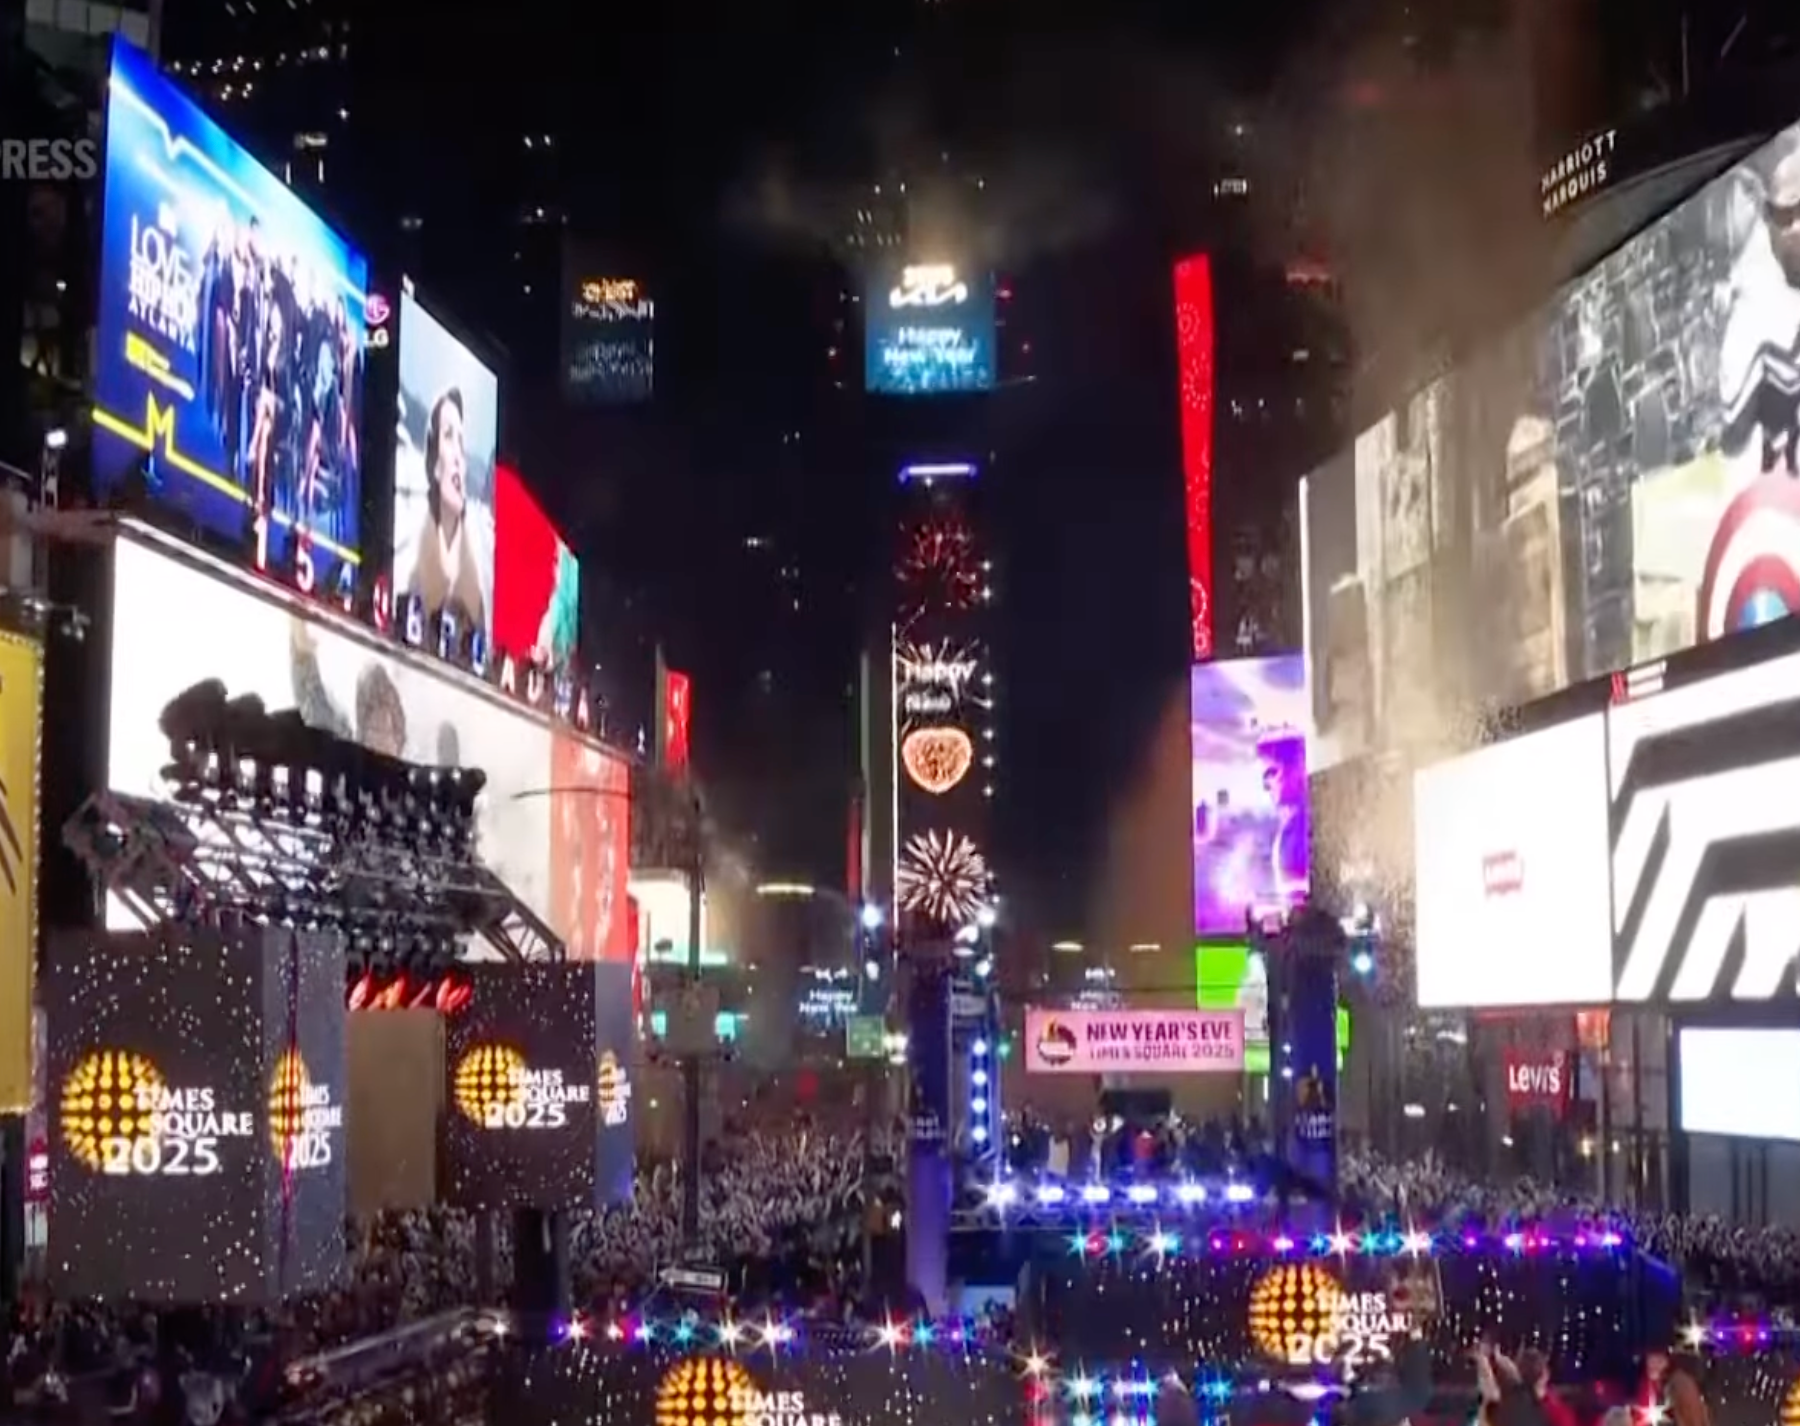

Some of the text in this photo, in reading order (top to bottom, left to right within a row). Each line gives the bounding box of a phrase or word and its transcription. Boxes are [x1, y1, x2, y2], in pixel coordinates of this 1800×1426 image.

[1086, 1021, 1233, 1042] NEW YEAR'S EVE
[1192, 1042, 1234, 1058] 2025
[508, 1068, 563, 1087] TIMES
[133, 1086, 214, 1112] TIMES
[519, 1085, 589, 1104] SQUARE
[149, 1112, 253, 1139] SQUARE
[484, 1103, 567, 1129] 2025
[102, 1136, 219, 1175] 2025
[1317, 1291, 1386, 1313] TIMES
[729, 1390, 805, 1412] TIMES
